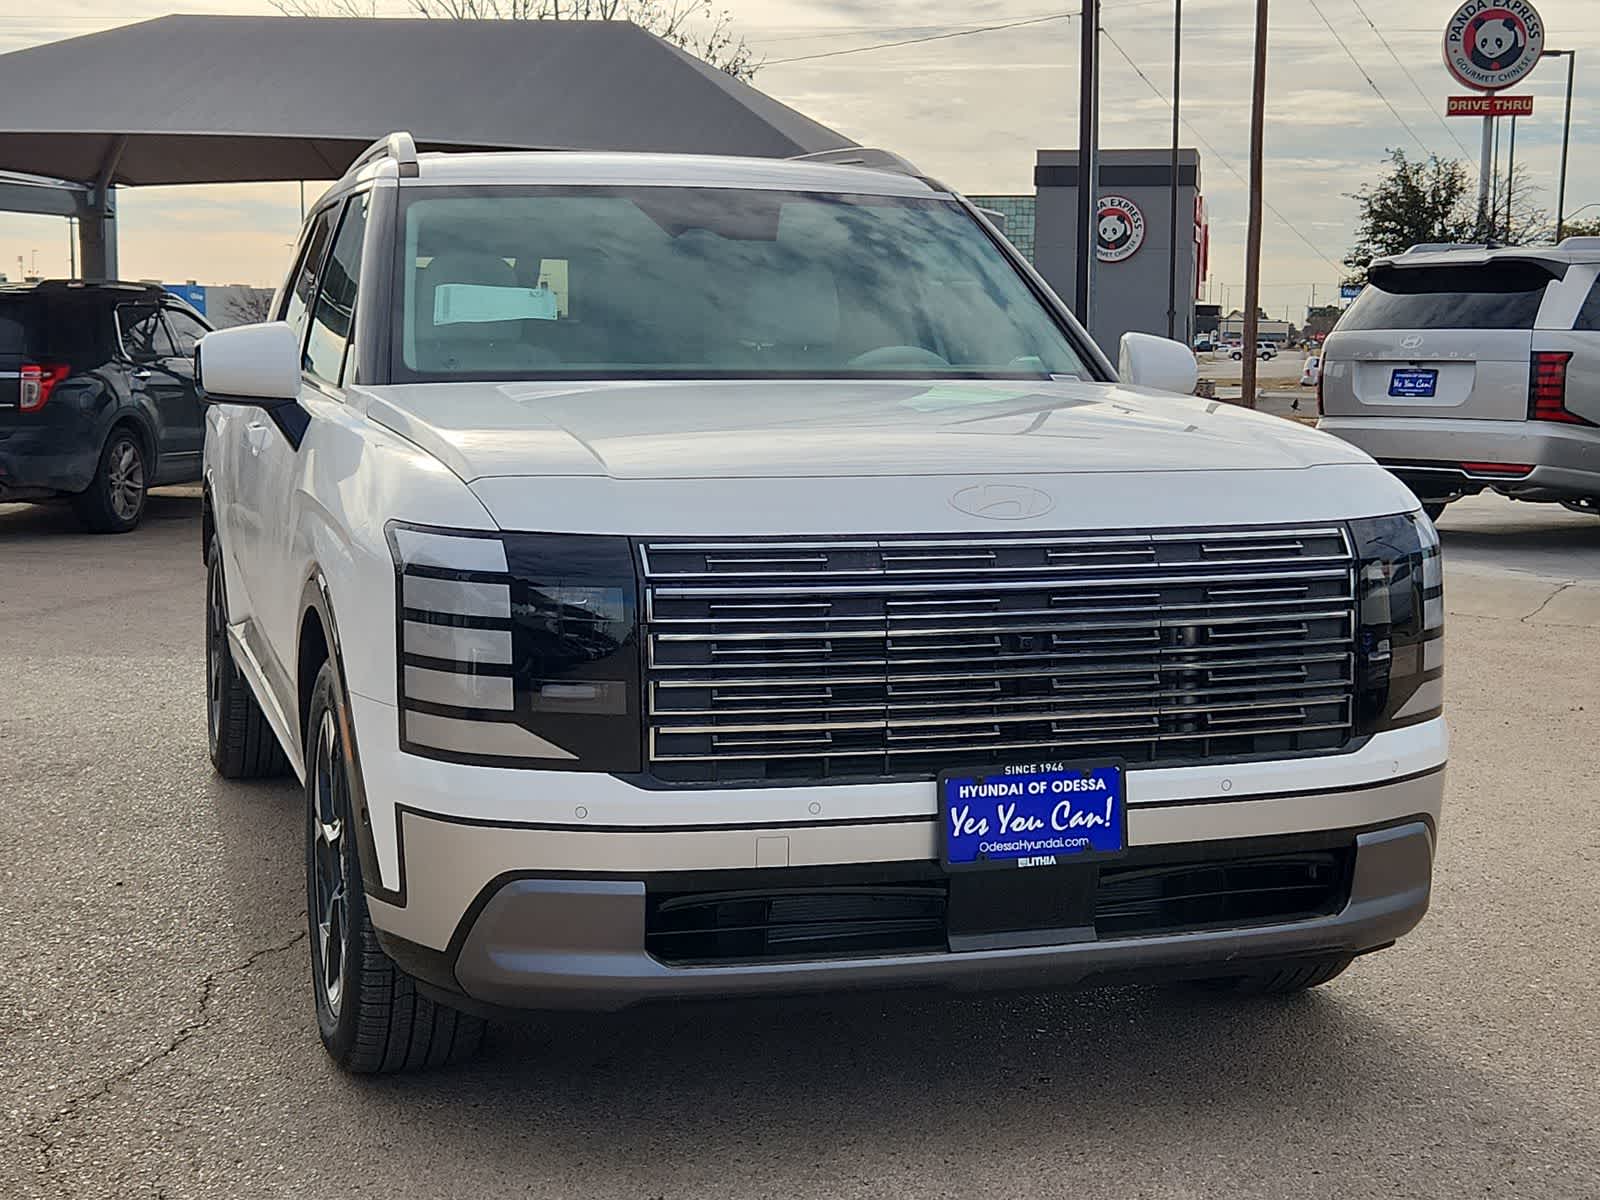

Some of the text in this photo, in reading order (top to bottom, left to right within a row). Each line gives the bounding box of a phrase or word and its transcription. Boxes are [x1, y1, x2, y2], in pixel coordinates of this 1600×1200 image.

[1450, 0, 1540, 42] PANDA EXPRESS
[1456, 58, 1495, 82] GOURMET
[1449, 100, 1532, 110] DRIVE THRU
[1110, 199, 1142, 230] EXPRESS
[1004, 762, 1064, 775] SINCE 1946
[959, 778, 1106, 798] HYUNDAI OF ODESSA
[951, 796, 1113, 837] Yes You Can!
[979, 837, 1089, 853] OdessaHyundai.com
[1026, 855, 1056, 867] LITHIA
